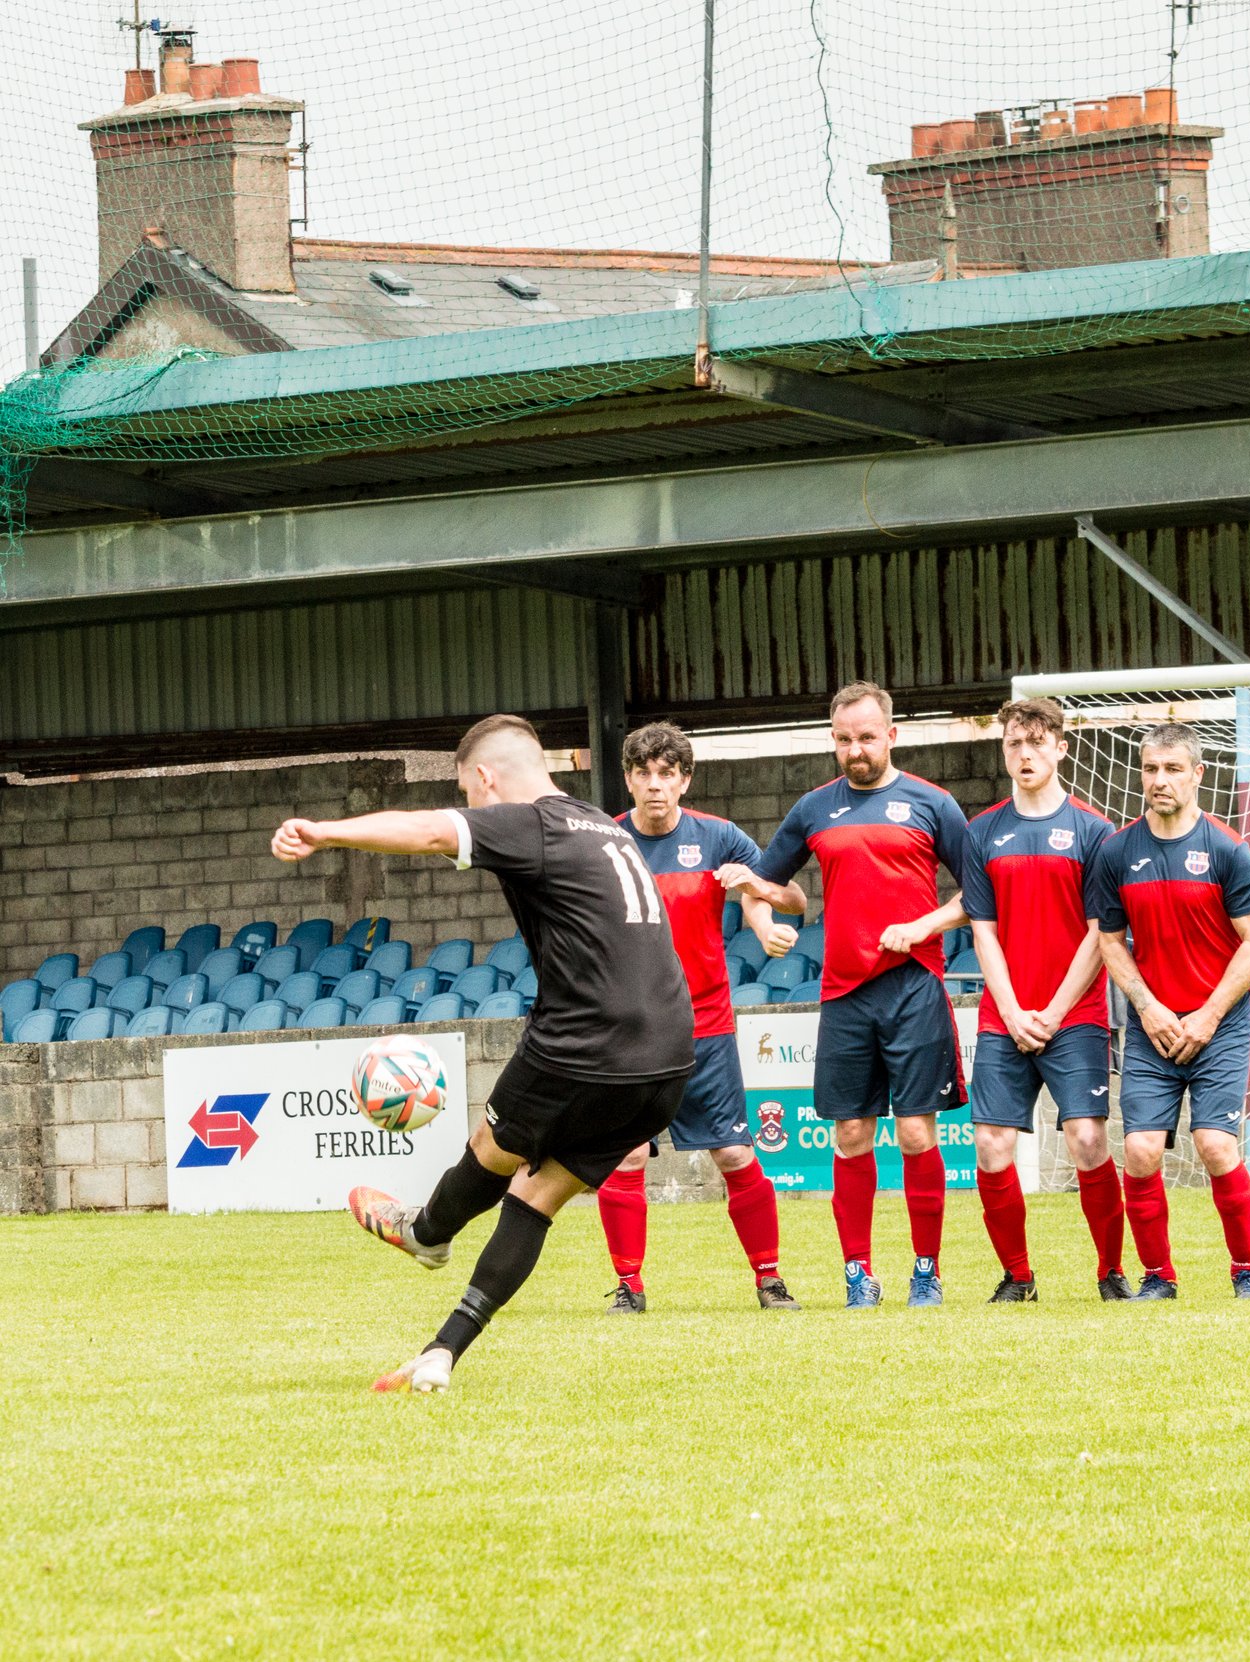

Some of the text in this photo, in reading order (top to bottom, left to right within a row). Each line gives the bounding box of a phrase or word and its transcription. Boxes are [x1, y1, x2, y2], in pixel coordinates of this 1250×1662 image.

[601, 841, 662, 925] 11
[779, 1044, 817, 1064] McCa
[371, 1078, 402, 1095] mitre
[314, 1129, 415, 1159] FERRIES
